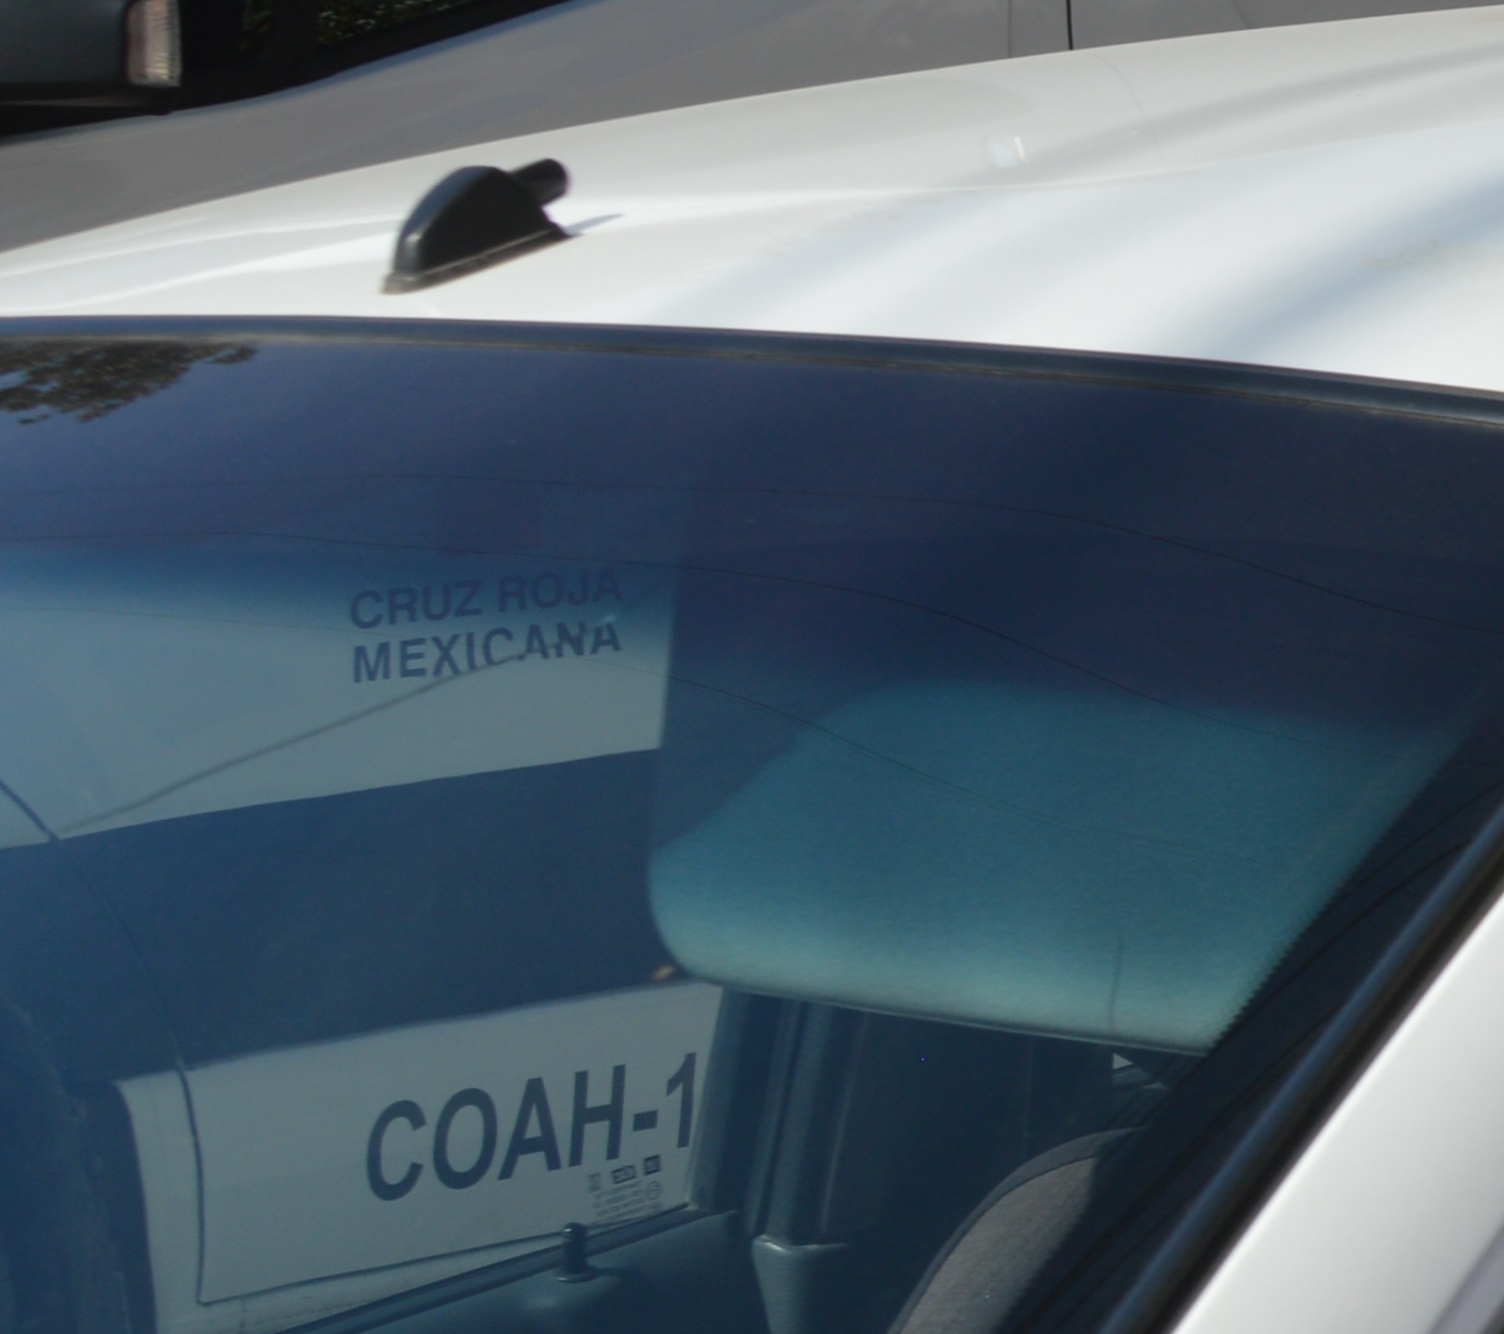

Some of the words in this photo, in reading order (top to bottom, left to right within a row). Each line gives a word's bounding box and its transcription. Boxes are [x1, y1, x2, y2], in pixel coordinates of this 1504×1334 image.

[350, 579, 483, 630] CRUZ
[499, 570, 625, 614] ROJA
[352, 620, 622, 684] MEXICANA
[366, 1051, 698, 1203] COAH-1
